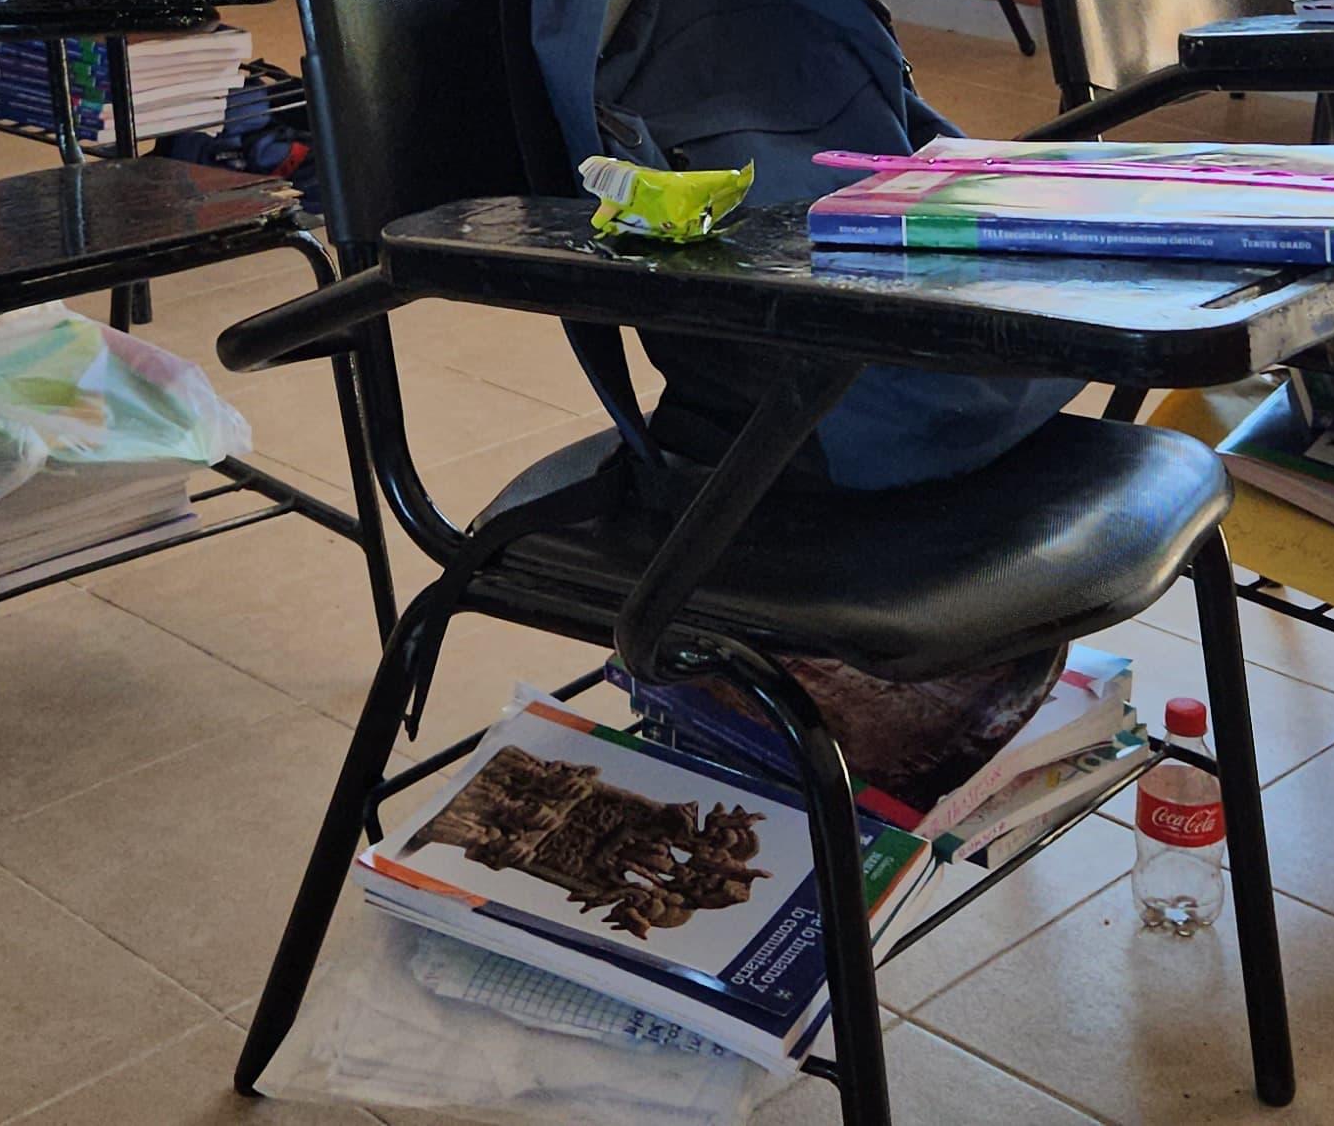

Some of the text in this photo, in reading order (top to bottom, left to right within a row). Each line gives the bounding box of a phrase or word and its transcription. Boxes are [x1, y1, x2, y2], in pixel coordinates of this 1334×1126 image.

[1062, 232, 1098, 243] Saberes
[1099, 235, 1105, 245] y
[1106, 234, 1167, 246] pensamiento
[730, 906, 815, 985] lo comunitario
[761, 937, 816, 984] humano
[748, 977, 769, 995] y
